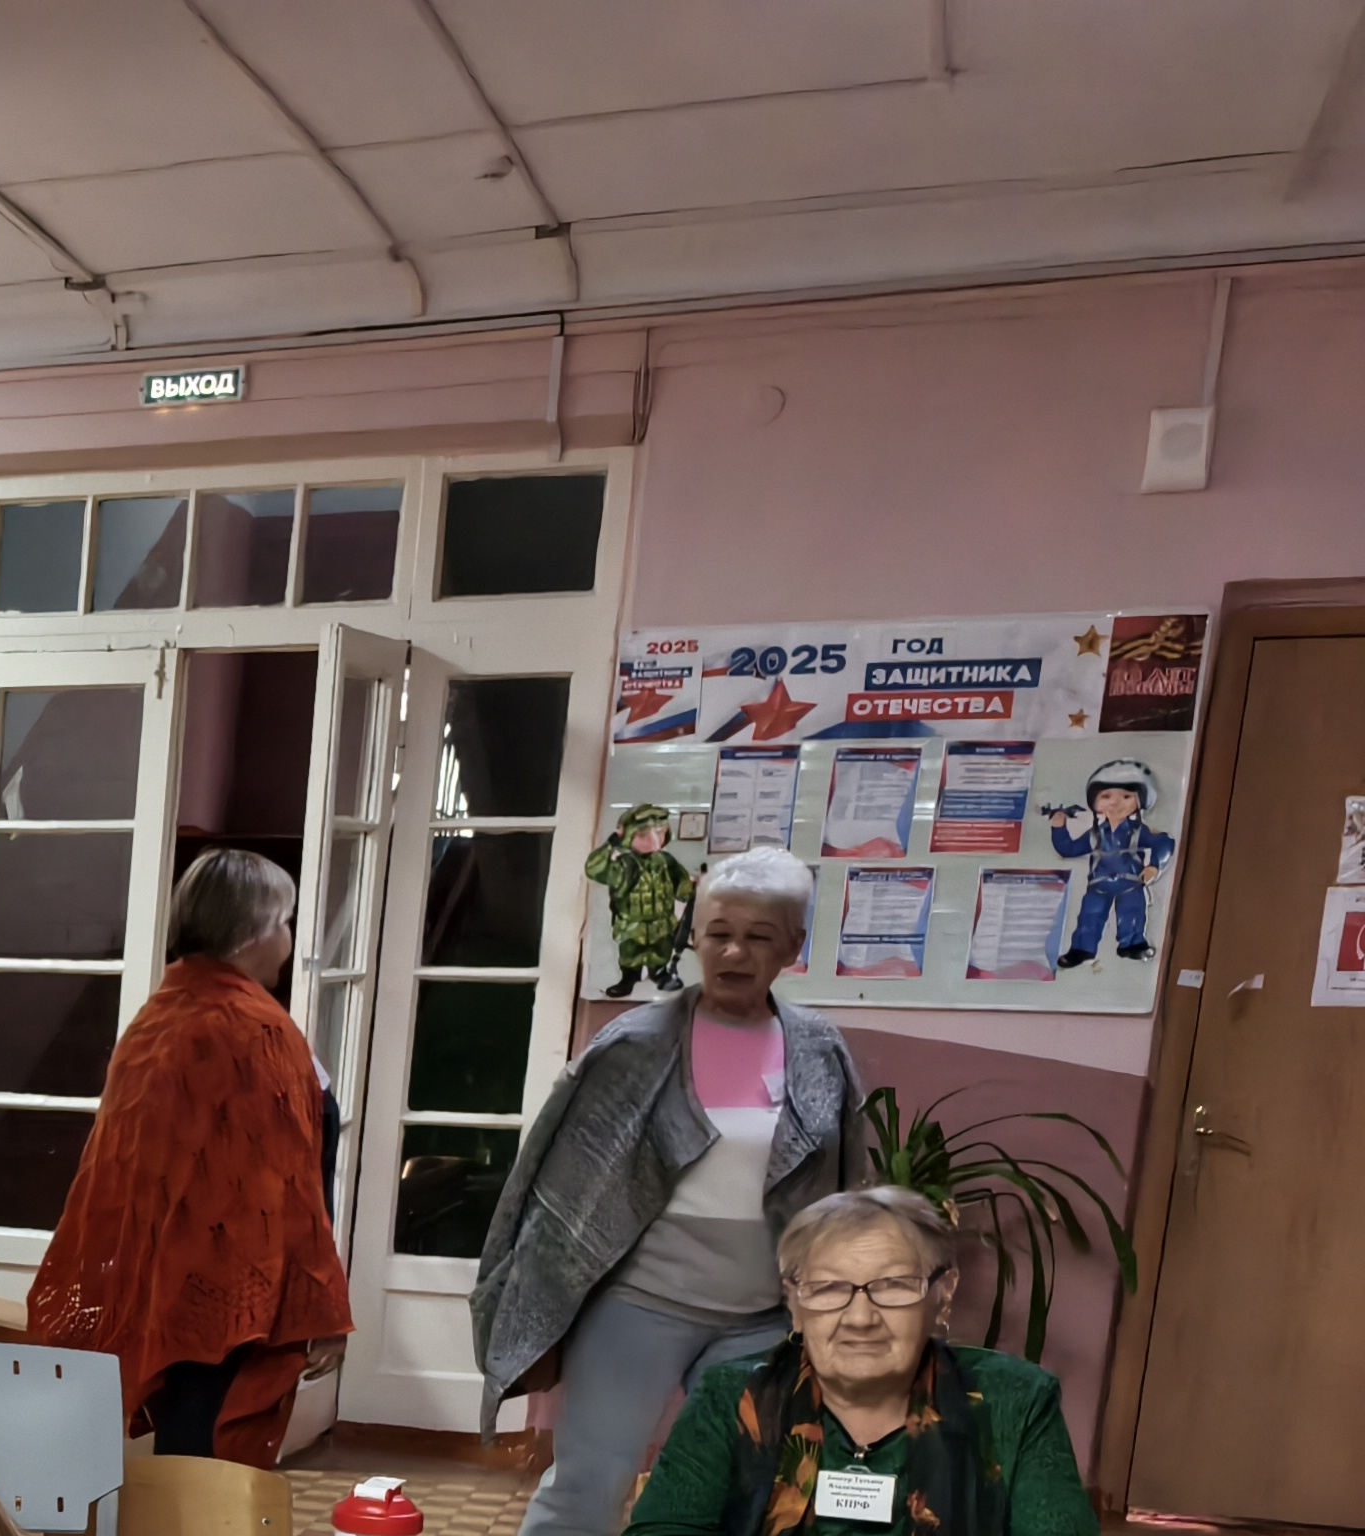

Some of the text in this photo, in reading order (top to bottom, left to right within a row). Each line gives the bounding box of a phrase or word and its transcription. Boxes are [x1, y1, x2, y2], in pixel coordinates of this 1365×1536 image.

[150, 373, 235, 398] ВЫХОД
[646, 640, 699, 655] 2025
[891, 637, 944, 655] ГОД
[728, 643, 847, 676] 2025
[871, 664, 1032, 686] ЗАЩИТНИКА
[852, 696, 1005, 716] ОТЕЧЕСТВА
[836, 1499, 870, 1509] КПРФ
